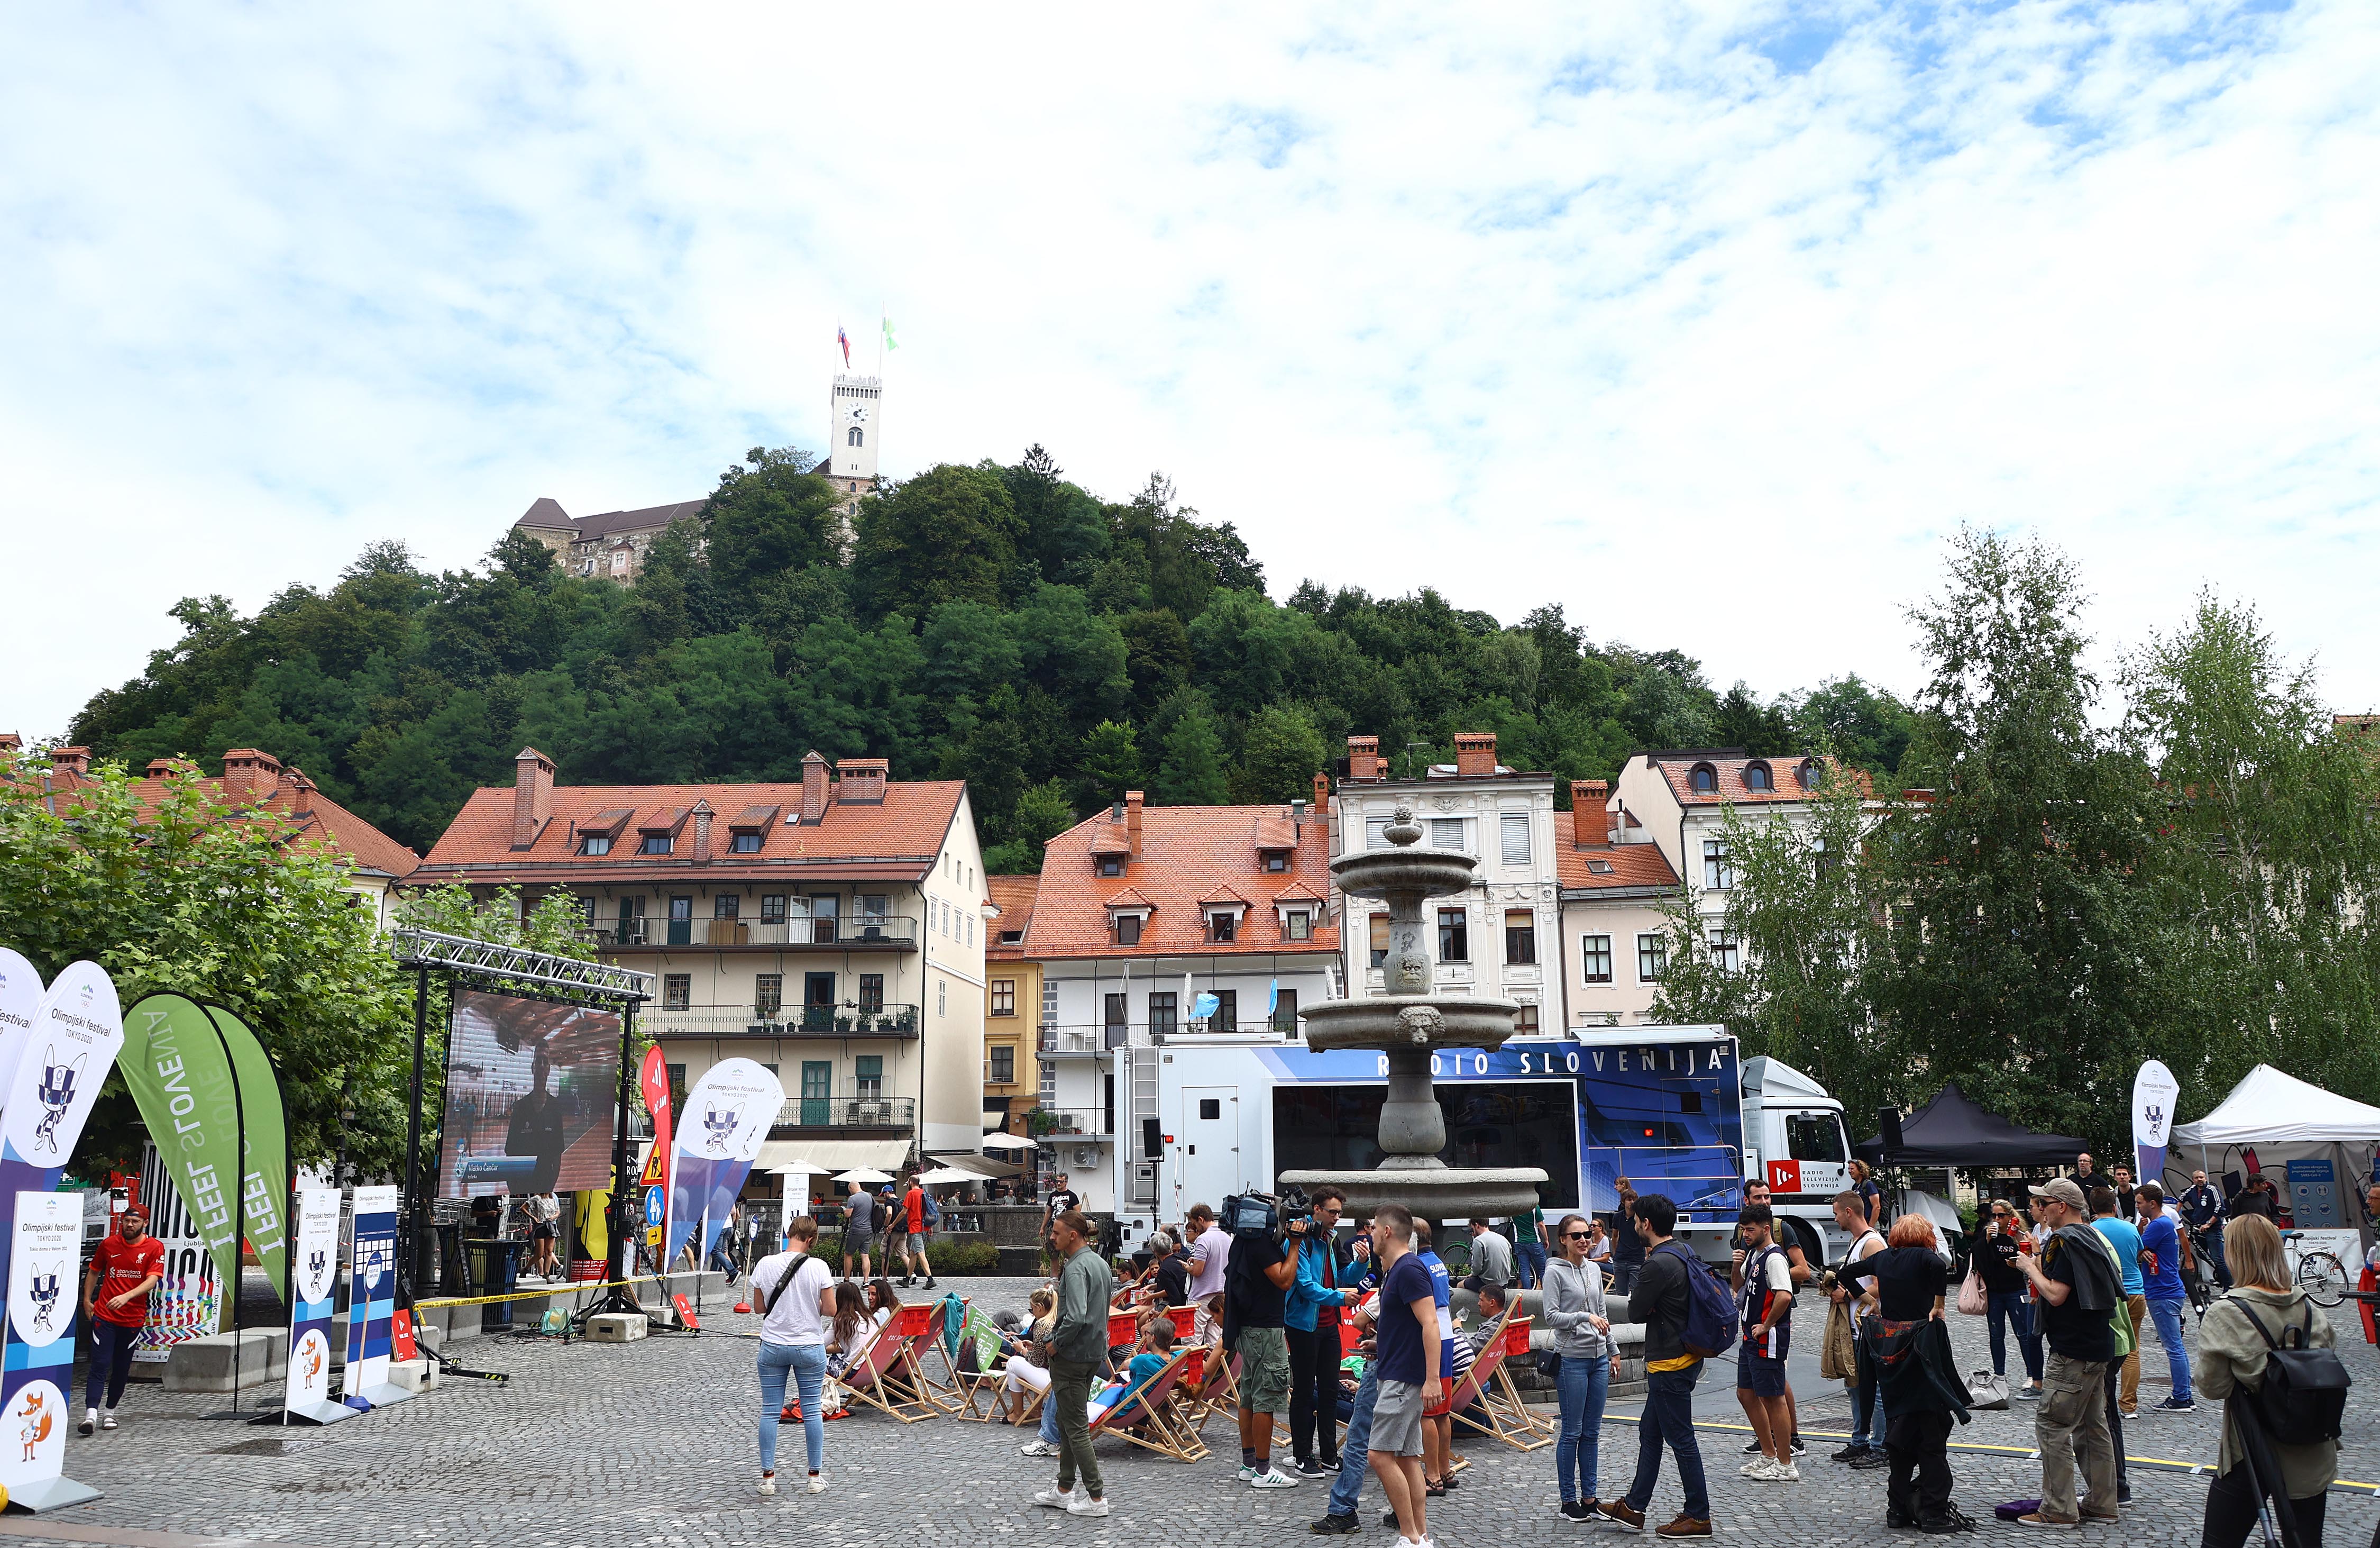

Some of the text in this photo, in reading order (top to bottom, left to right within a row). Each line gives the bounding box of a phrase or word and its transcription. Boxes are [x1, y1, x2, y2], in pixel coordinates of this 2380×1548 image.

[51, 1008, 112, 1037] Olimpijski festival
[66, 1028, 93, 1044] TOKYO 2020
[1377, 1049, 1723, 1076] RDIO SLOVENIJA
[469, 1162, 498, 1172] Vlatko Čančar
[22, 1223, 76, 1233] Olimpijski festival
